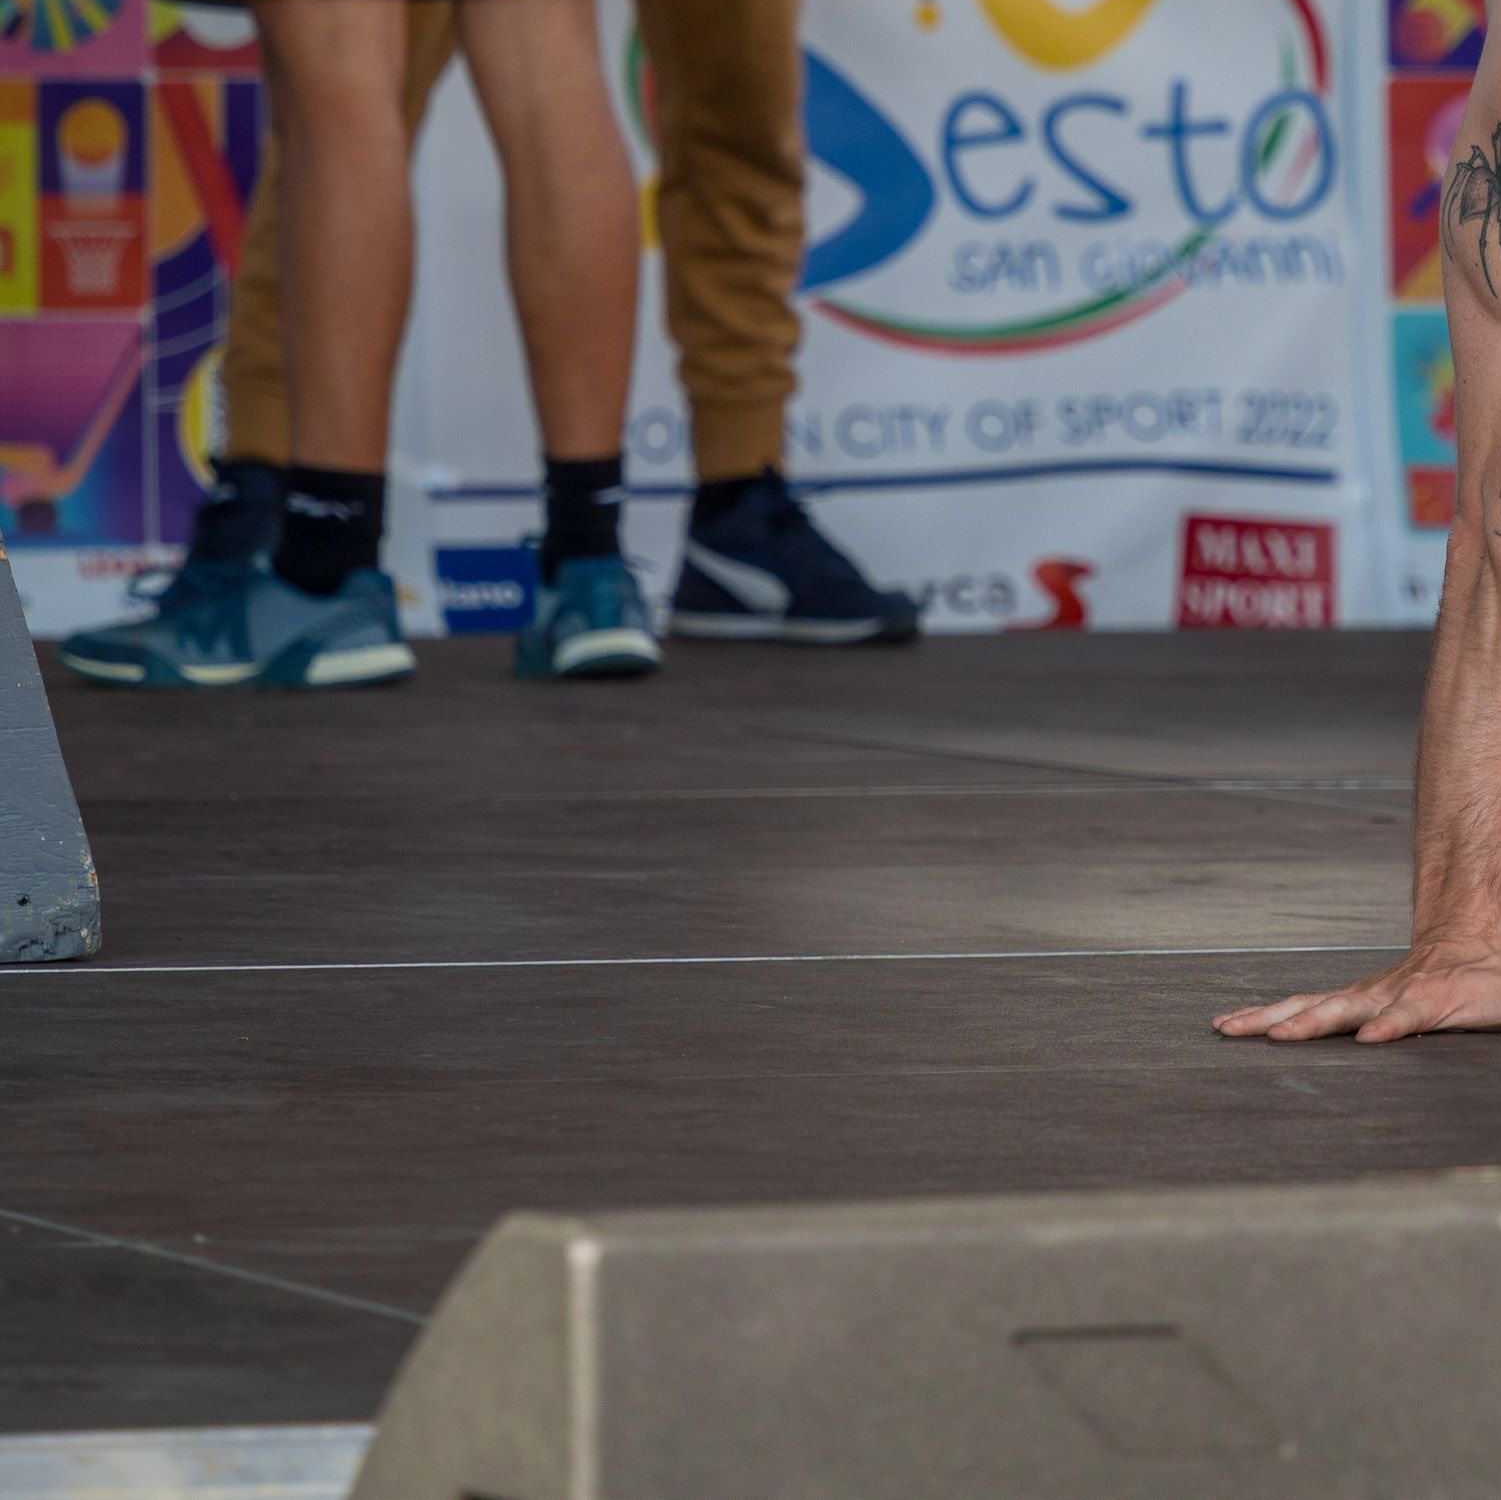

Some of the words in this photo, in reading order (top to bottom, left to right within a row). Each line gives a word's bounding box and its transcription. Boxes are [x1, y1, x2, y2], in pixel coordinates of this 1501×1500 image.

[834, 401, 950, 460] CITY
[966, 397, 1042, 454] OF
[1056, 384, 1223, 446] SPORT
[1235, 386, 1338, 450] 2022
[1196, 521, 1318, 578] MAXI
[1181, 573, 1324, 630] SPORT
